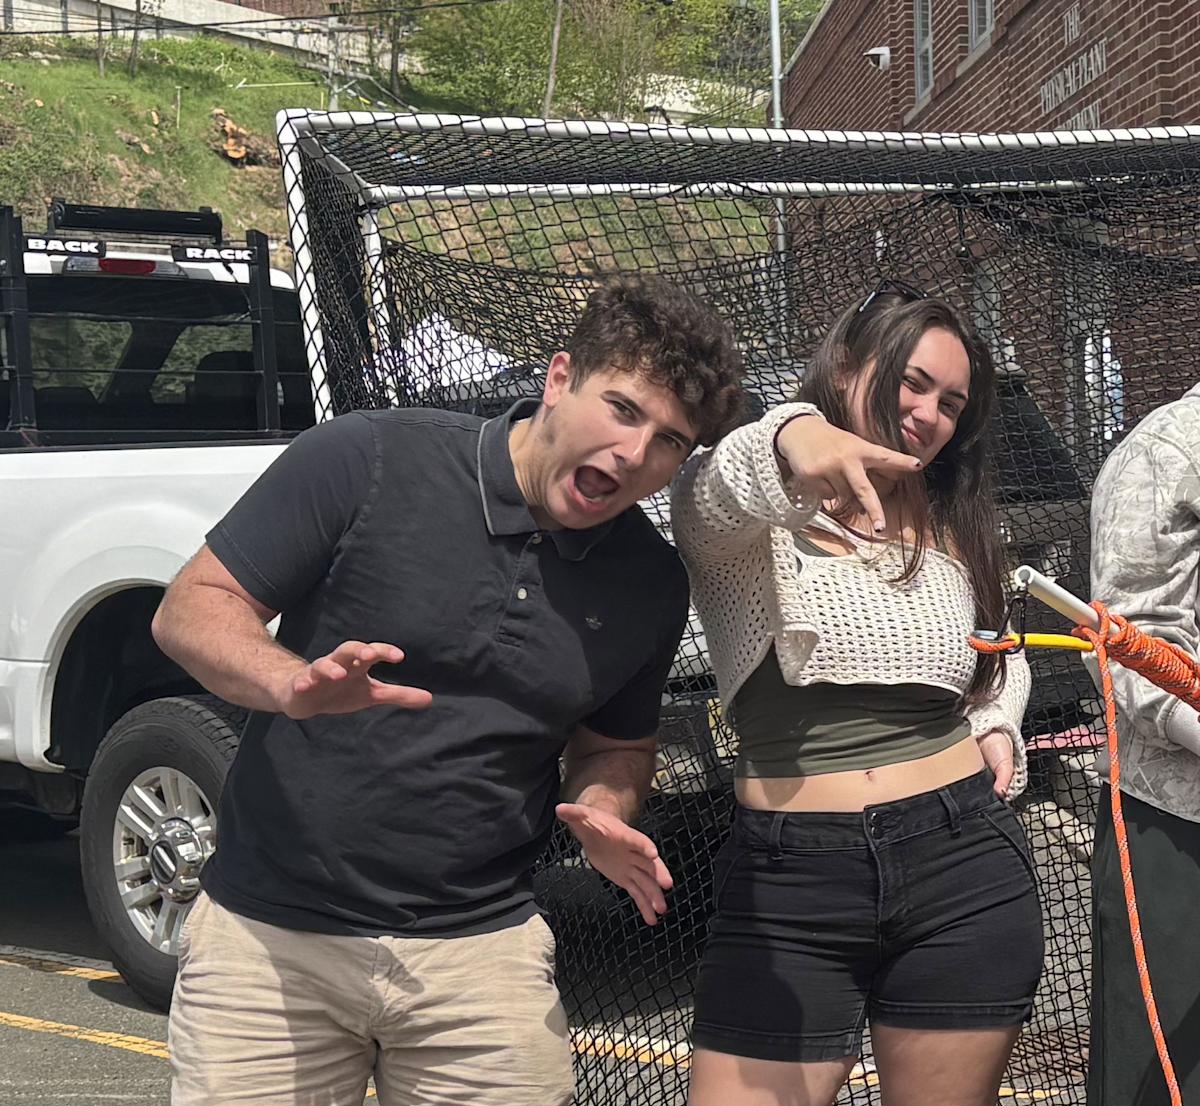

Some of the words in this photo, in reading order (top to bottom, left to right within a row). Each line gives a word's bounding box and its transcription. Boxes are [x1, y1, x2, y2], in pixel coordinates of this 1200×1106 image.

[1063, 2, 1080, 46] THE
[1079, 36, 1108, 90] PLANT
[27, 238, 100, 254] BACK
[185, 247, 254, 261] RACK
